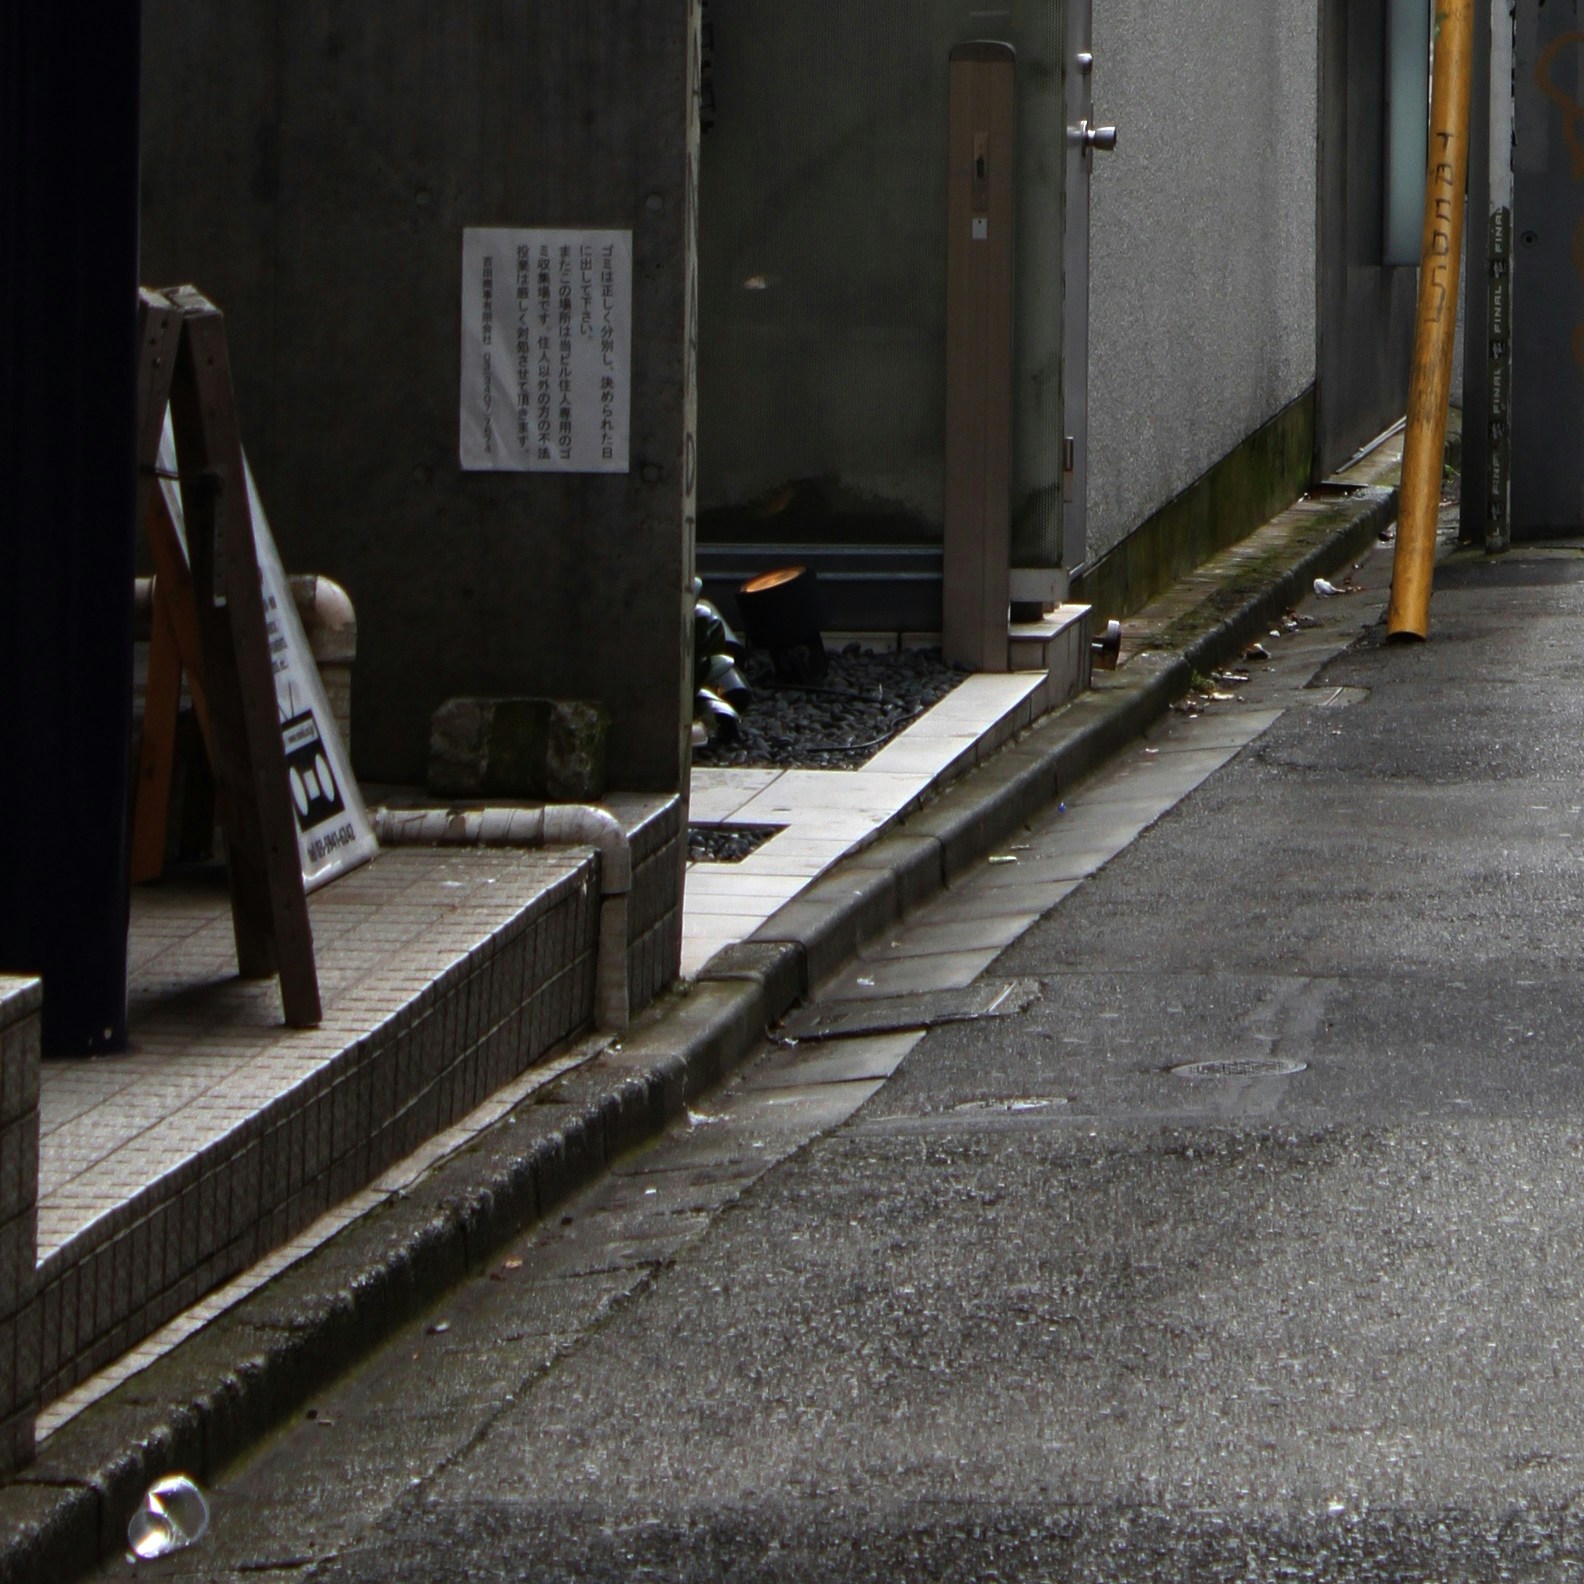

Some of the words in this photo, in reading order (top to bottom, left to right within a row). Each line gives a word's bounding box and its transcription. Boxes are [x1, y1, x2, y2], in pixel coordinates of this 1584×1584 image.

[579, 244, 593, 342] に出して下さい。
[1493, 285, 1503, 334] FINAL
[537, 245, 551, 460] ミ収集場です。住人以外の方の不法
[558, 244, 573, 460] またこの場所は当ビル住人専用のゴ
[1492, 368, 1502, 414] FINAL
